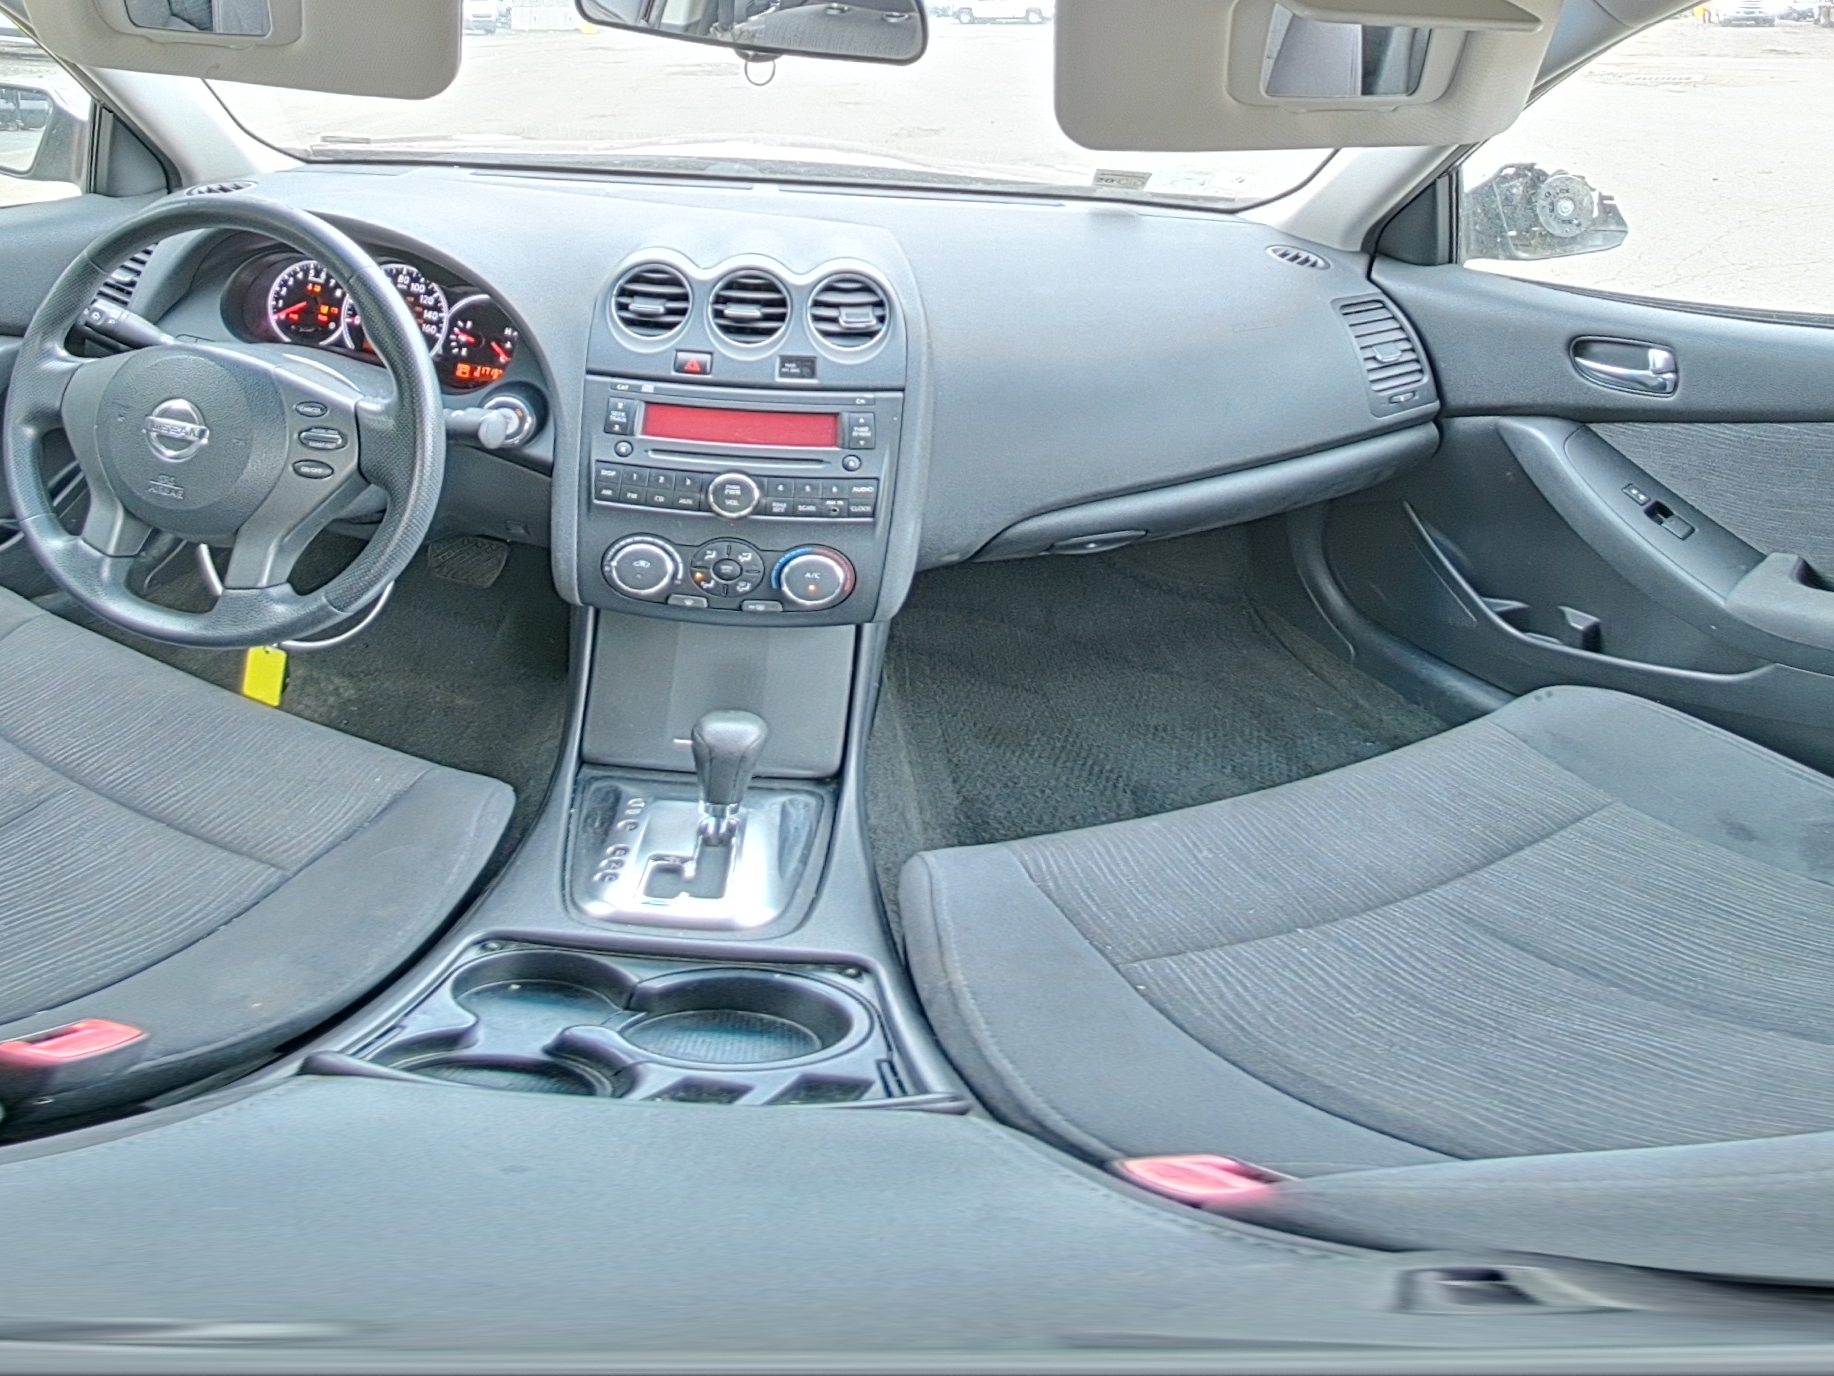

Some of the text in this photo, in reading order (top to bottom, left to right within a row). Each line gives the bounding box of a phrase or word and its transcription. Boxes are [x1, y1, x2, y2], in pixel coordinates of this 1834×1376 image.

[398, 274, 411, 284] 80
[410, 283, 426, 293] 100
[419, 295, 435, 305] 120
[423, 310, 439, 320] 140
[422, 324, 438, 334] 160
